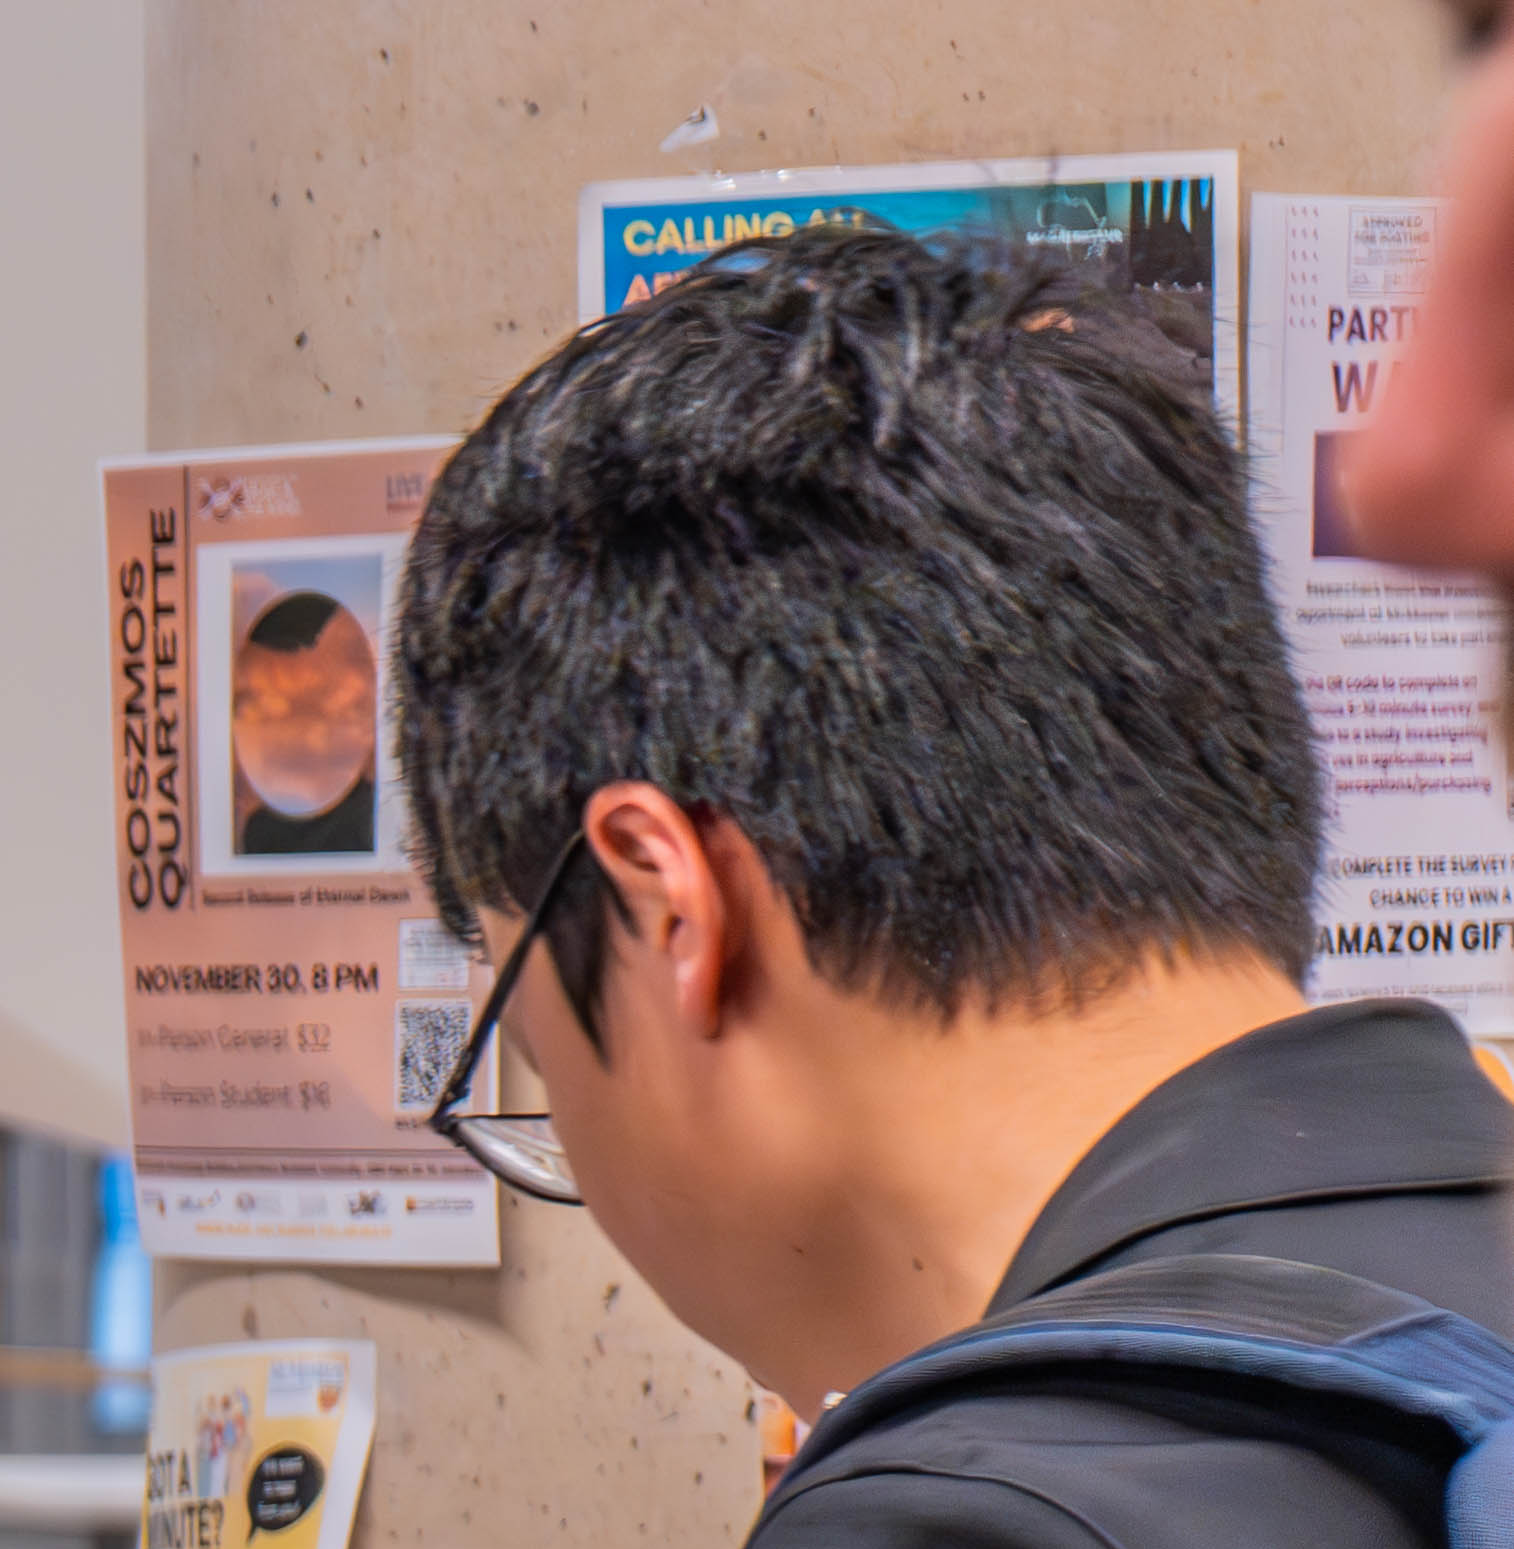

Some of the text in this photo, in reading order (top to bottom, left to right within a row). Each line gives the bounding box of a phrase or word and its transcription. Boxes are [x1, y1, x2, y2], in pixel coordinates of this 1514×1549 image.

[622, 209, 796, 257] CALLING
[150, 506, 193, 912] QUARTETTE
[121, 558, 154, 912] COSZMOS
[1416, 856, 1446, 874] THE
[1449, 854, 1506, 874] SURVEY
[1368, 887, 1513, 908] CHANCE TO WIN A
[1318, 920, 1454, 956] AMAZON
[135, 963, 261, 994] NOVEMBER
[311, 966, 330, 993] 8
[334, 965, 379, 993] PM
[177, 1449, 193, 1498] A
